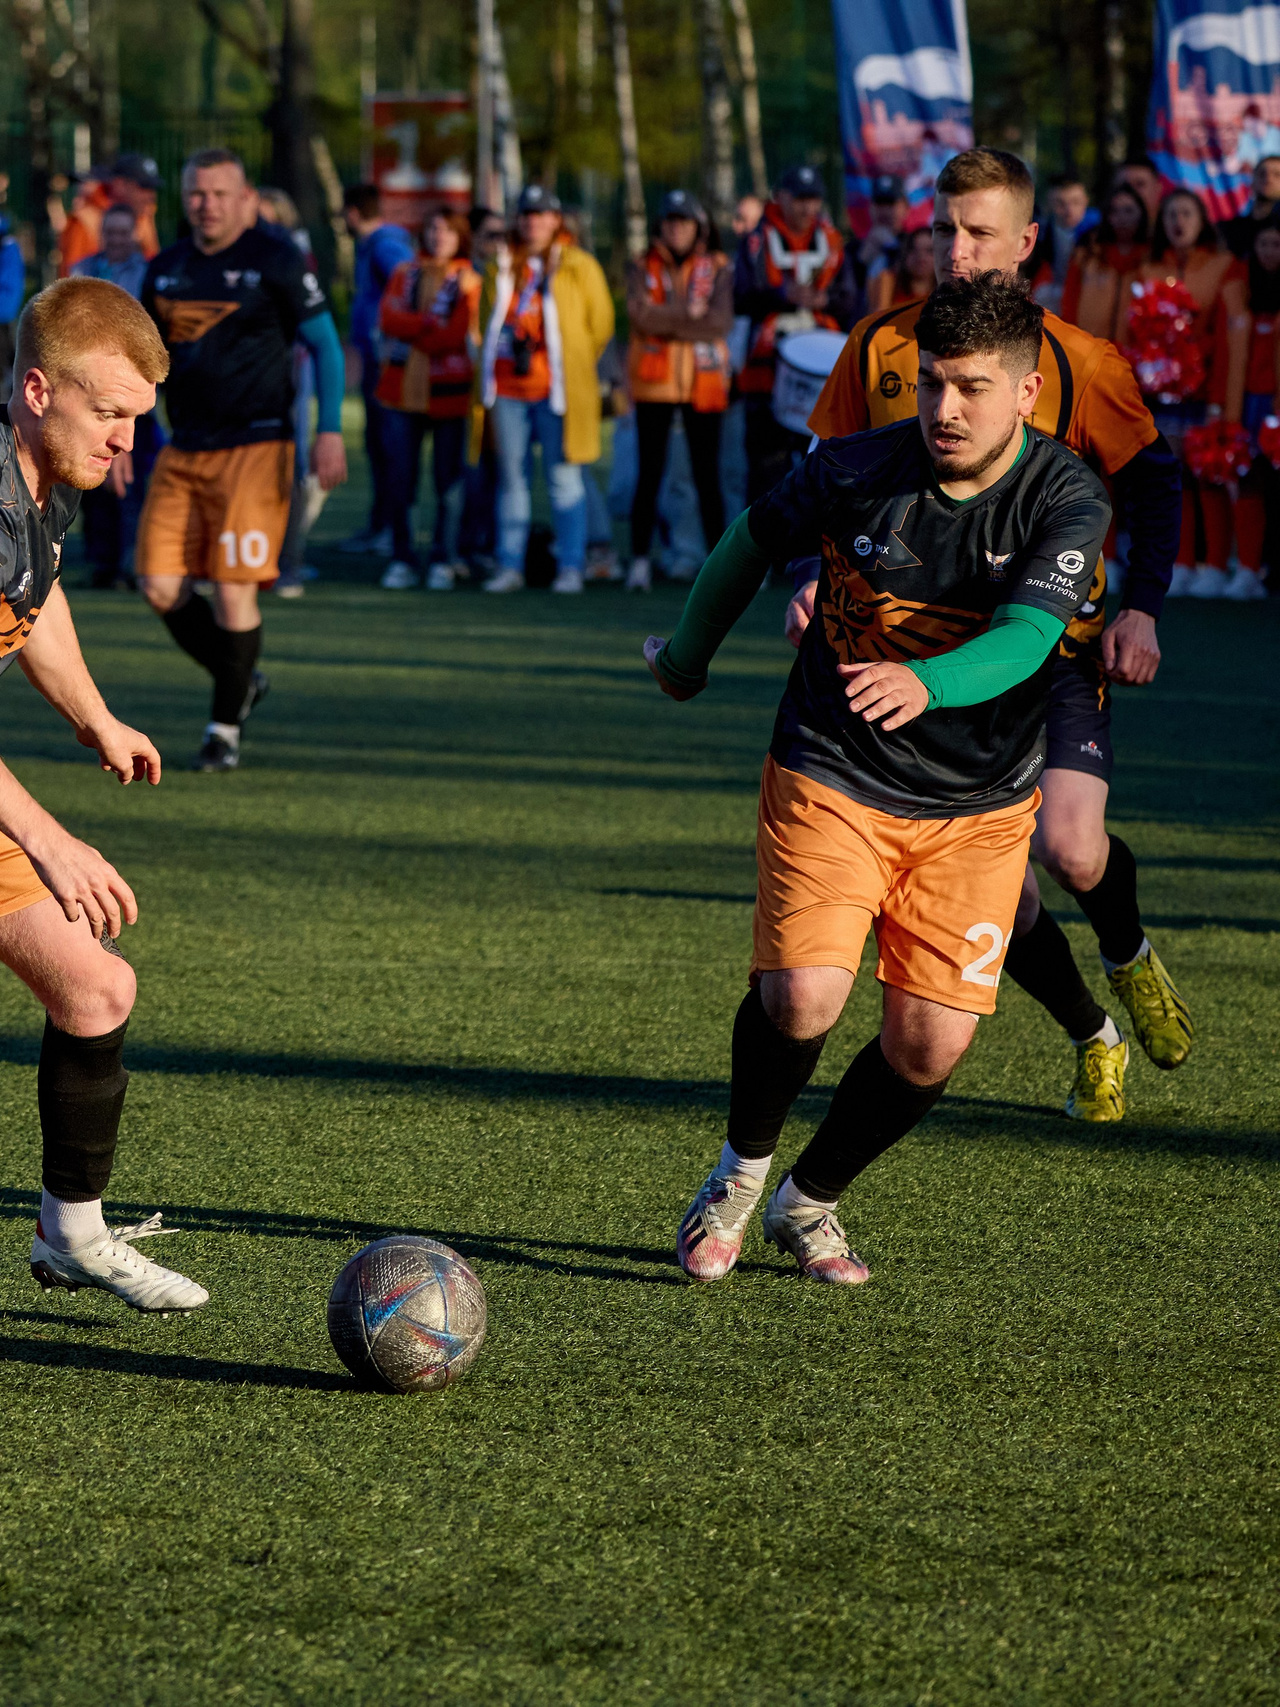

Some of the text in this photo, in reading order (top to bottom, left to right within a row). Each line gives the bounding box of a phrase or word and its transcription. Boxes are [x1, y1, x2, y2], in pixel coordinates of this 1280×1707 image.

[219, 530, 269, 568] 10
[1049, 572, 1076, 589] ТМХ
[960, 921, 1014, 988] 2
